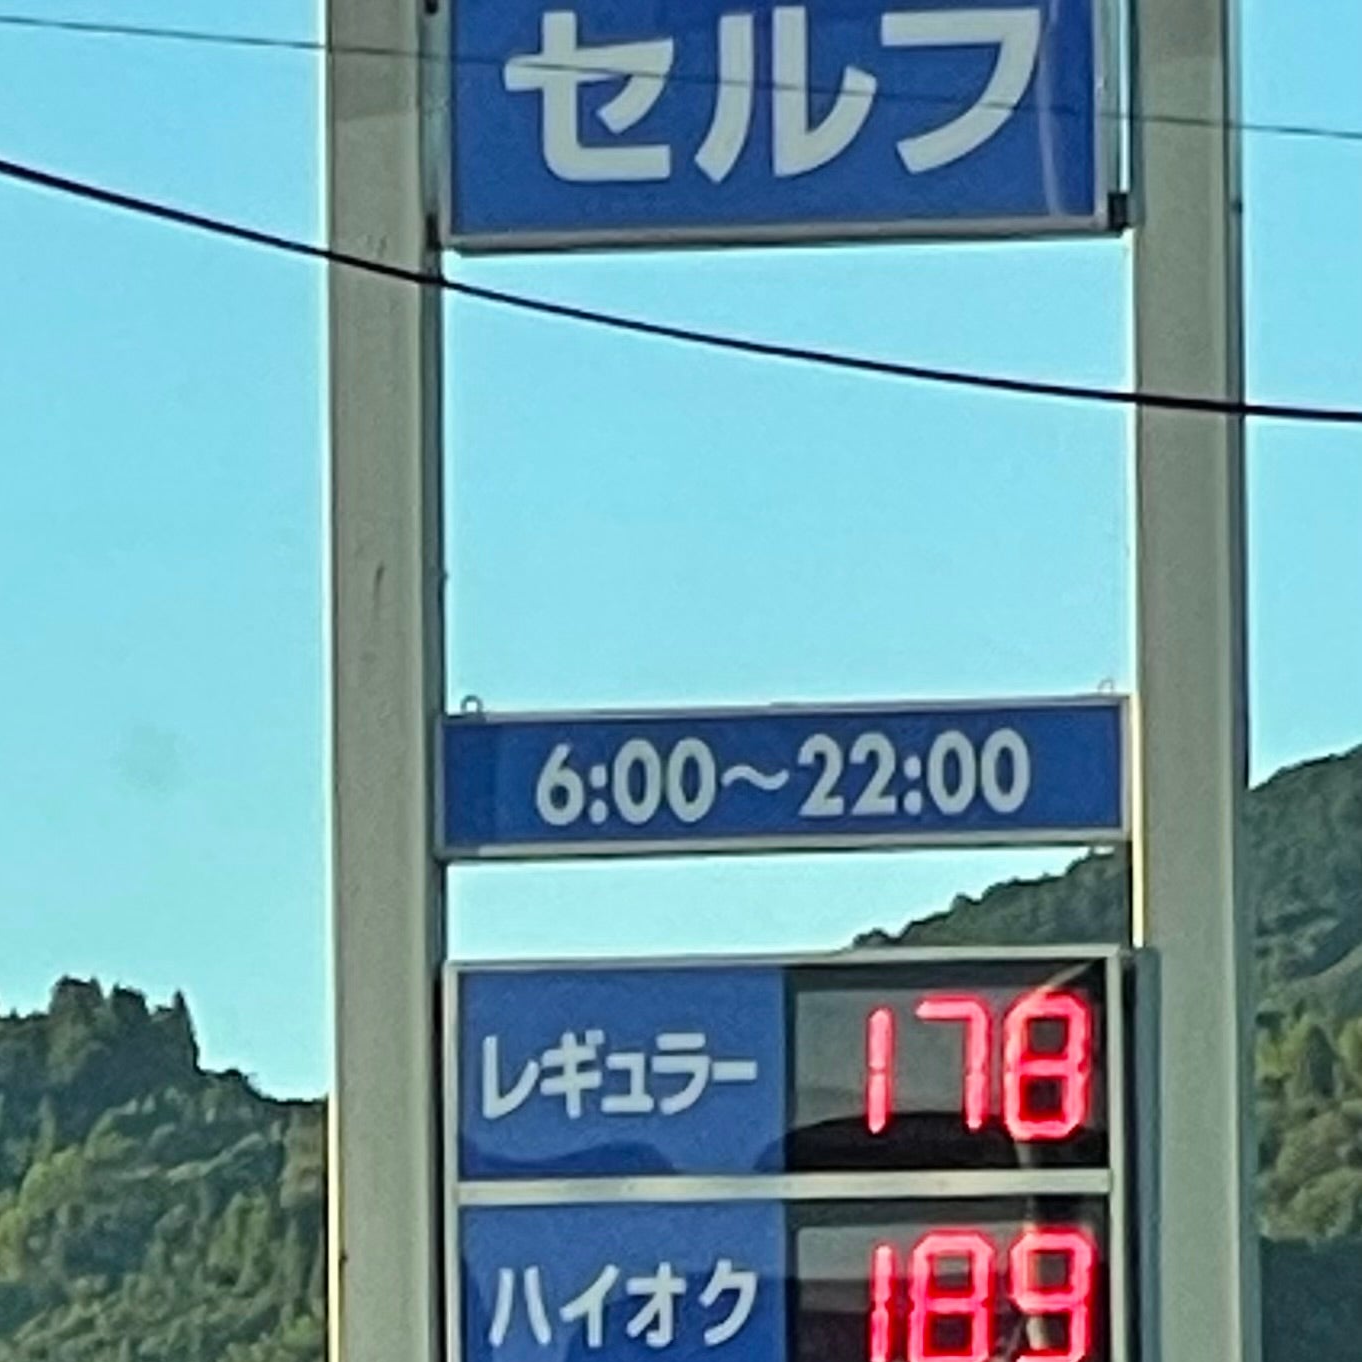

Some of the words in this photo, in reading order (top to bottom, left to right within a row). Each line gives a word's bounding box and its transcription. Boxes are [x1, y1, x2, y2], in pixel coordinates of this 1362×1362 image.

[504, 5, 1040, 183] セルフ
[482, 1028, 759, 1120] レギュラー
[865, 989, 1095, 1141] 178
[488, 1259, 760, 1350] ハイオク
